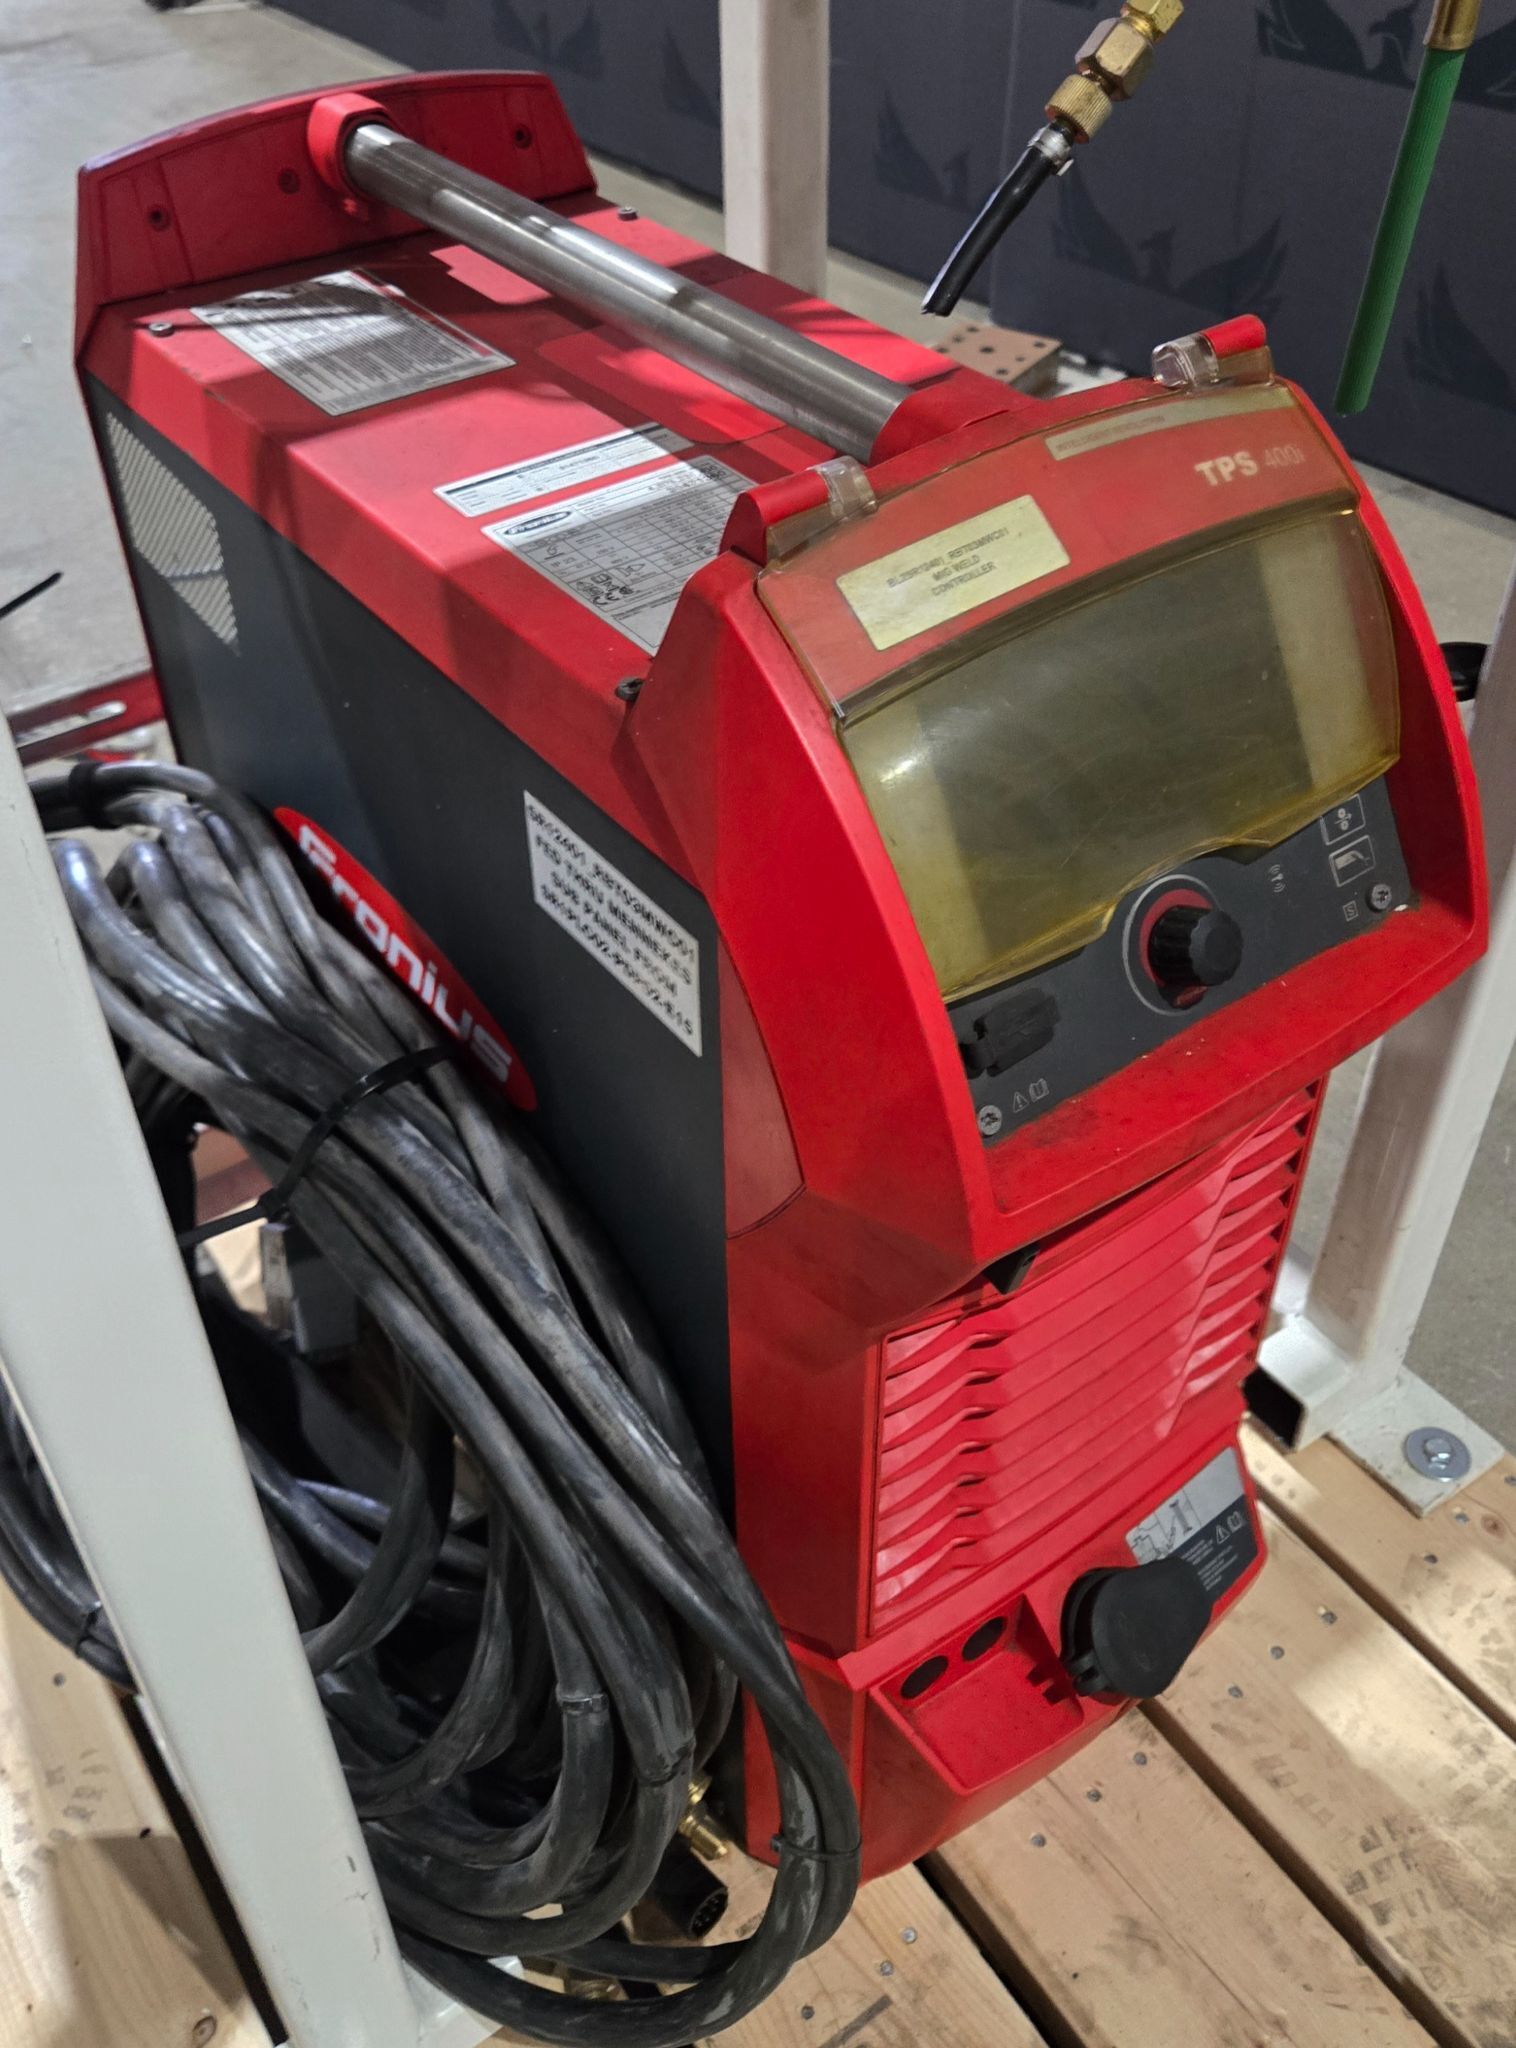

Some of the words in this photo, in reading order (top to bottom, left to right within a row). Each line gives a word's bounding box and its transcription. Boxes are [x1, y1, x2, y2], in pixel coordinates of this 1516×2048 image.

[1194, 451, 1258, 486] TPS
[930, 561, 996, 597] CONTROLLER
[931, 564, 954, 582] MIG
[952, 553, 982, 573] WELD
[297, 824, 512, 1083] Fronius
